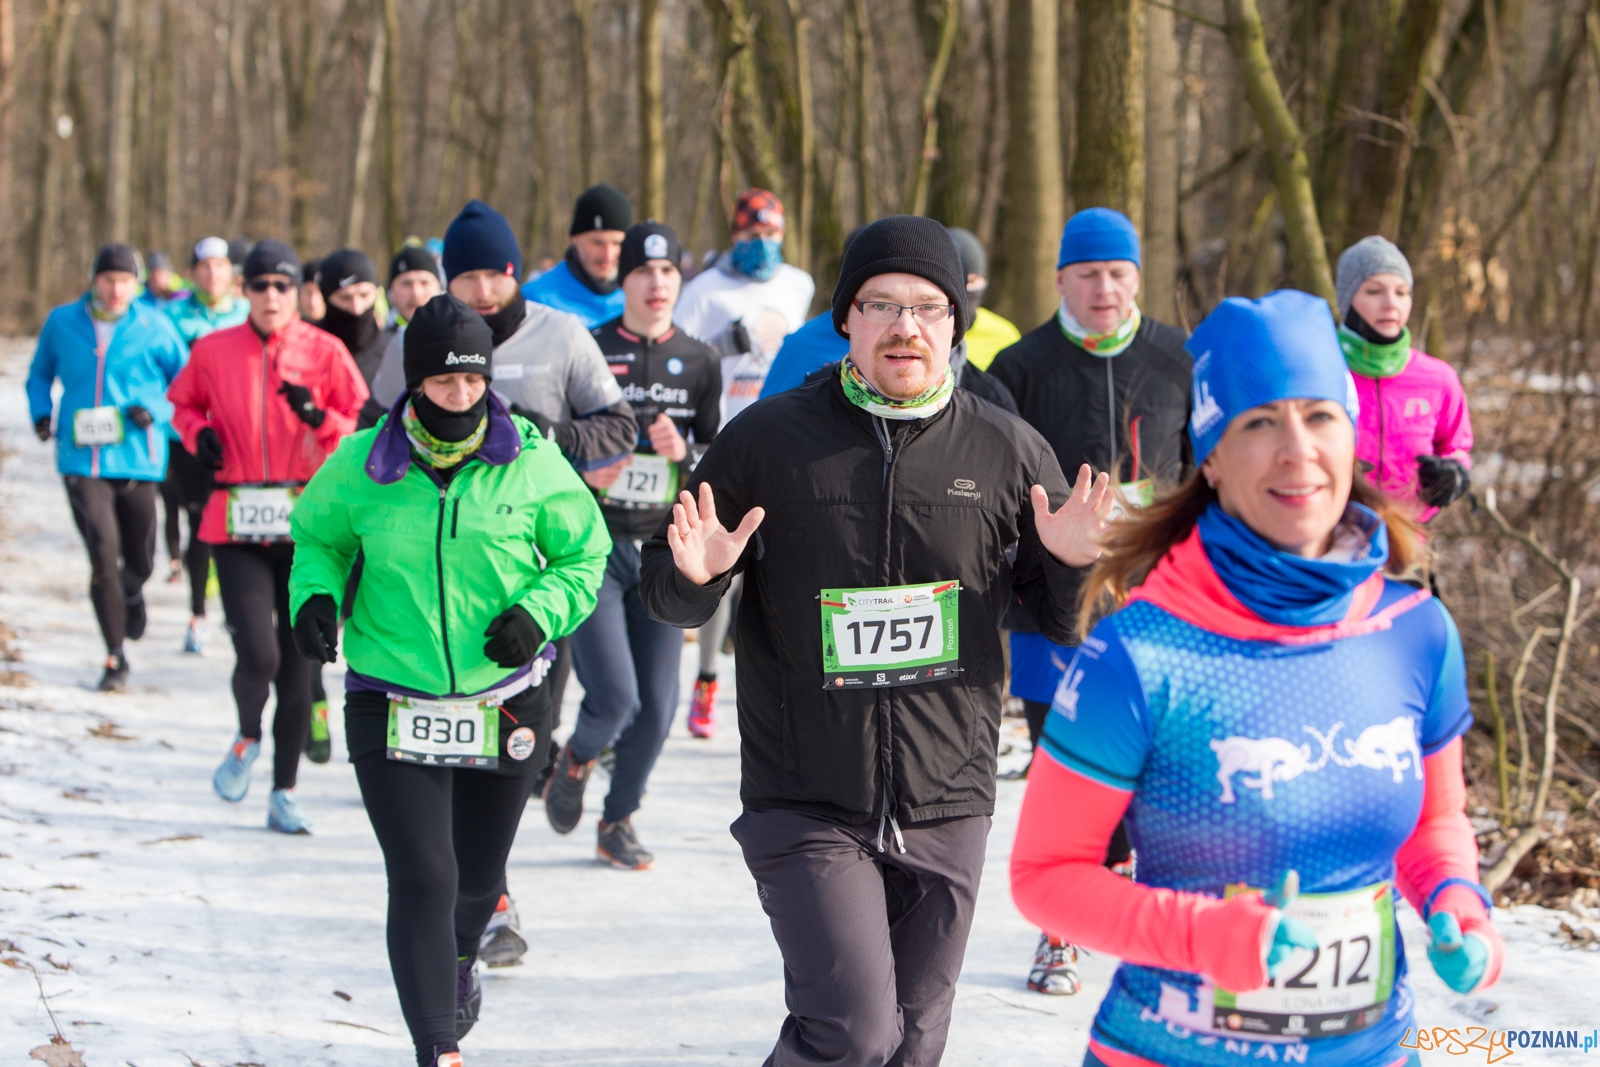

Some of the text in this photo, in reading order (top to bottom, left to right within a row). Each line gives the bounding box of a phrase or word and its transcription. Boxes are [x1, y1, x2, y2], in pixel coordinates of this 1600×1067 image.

[626, 470, 658, 492] 121
[239, 505, 289, 523] 1204
[846, 614, 935, 655] 1757
[411, 715, 475, 744] 830
[1268, 935, 1370, 989] 212
